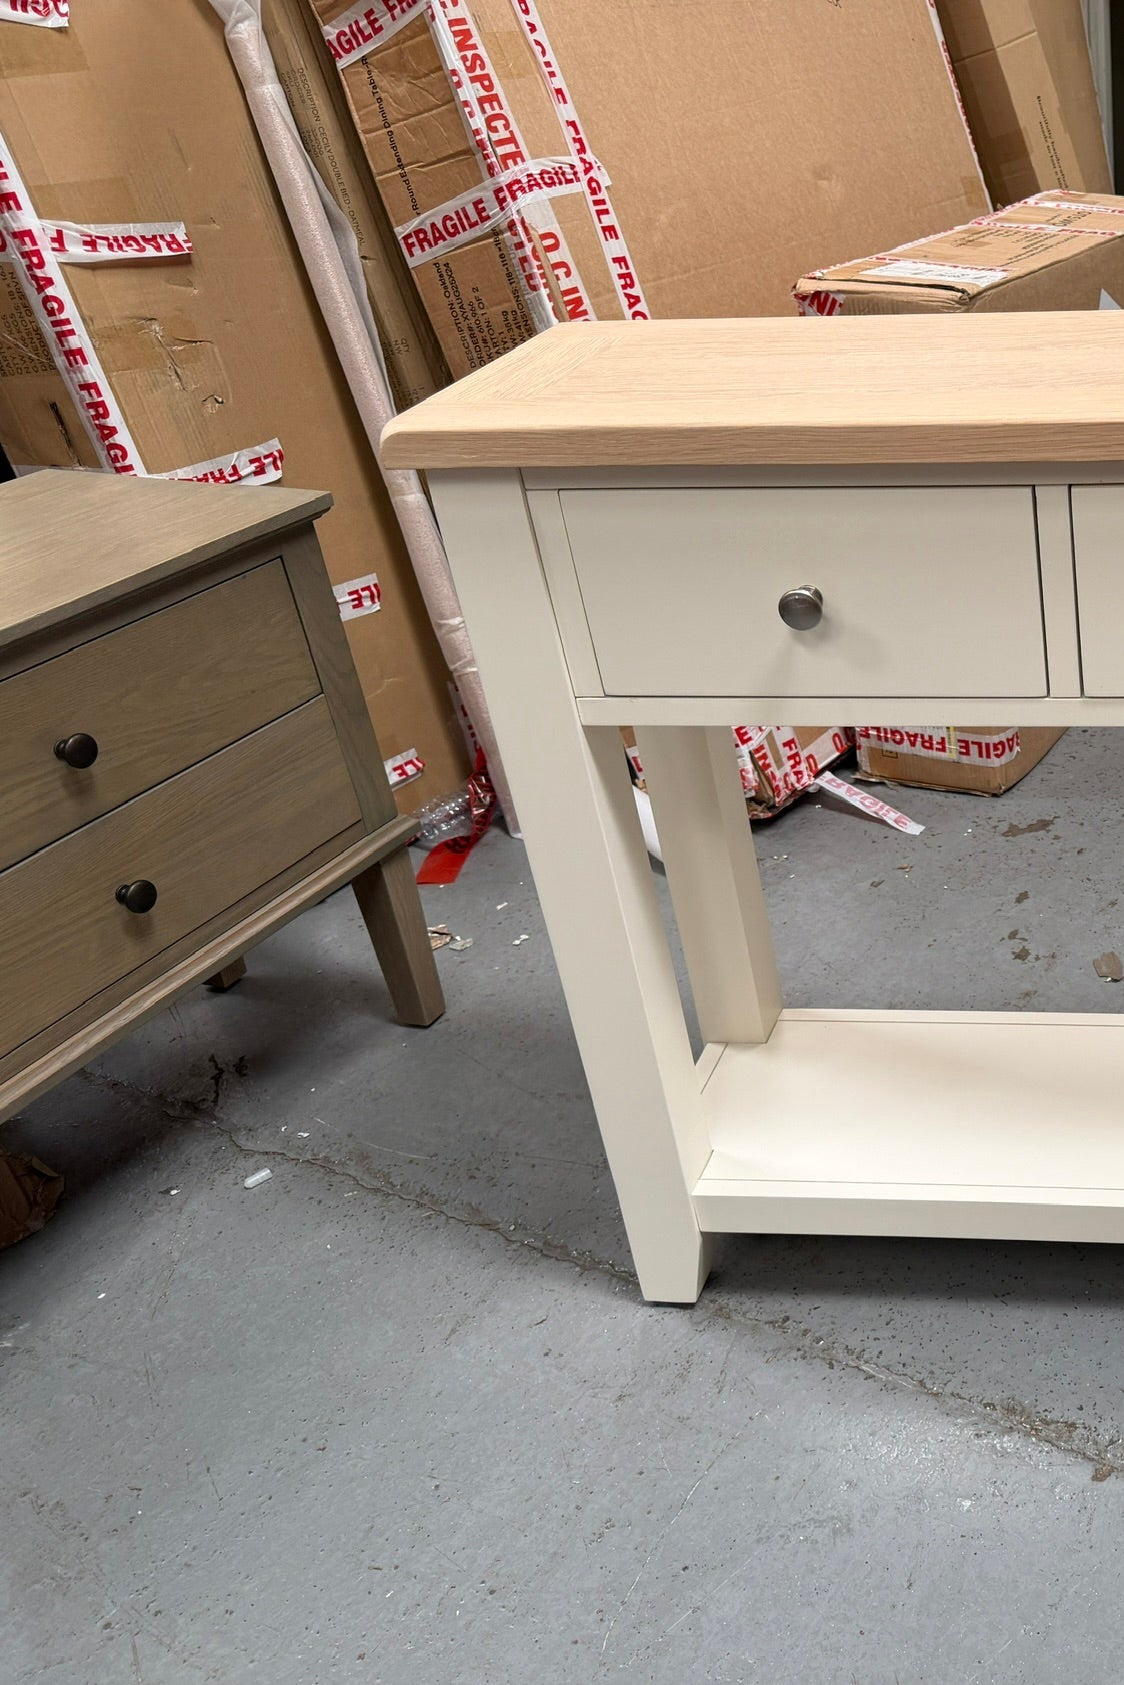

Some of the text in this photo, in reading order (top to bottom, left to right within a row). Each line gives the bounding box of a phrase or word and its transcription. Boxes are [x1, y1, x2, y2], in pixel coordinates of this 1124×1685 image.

[374, 96, 391, 129] Dining
[447, 17, 527, 171] INSPECTE
[385, 129, 407, 178] Extending
[401, 178, 419, 211] Round
[346, 209, 367, 246] OATMEAL
[402, 198, 492, 258] FRAGILE
[20, 300, 33, 317] OF
[471, 285, 479, 293] 2
[473, 293, 485, 310] OF
[432, 261, 477, 368] DESCRIPTION: Oakland
[467, 300, 485, 334] 610.966
[12, 228, 138, 477] FRAGILE FRAGI
[28, 318, 55, 370] PRODUCT
[465, 321, 486, 367] ORDER#:
[482, 317, 502, 358] ARTON:
